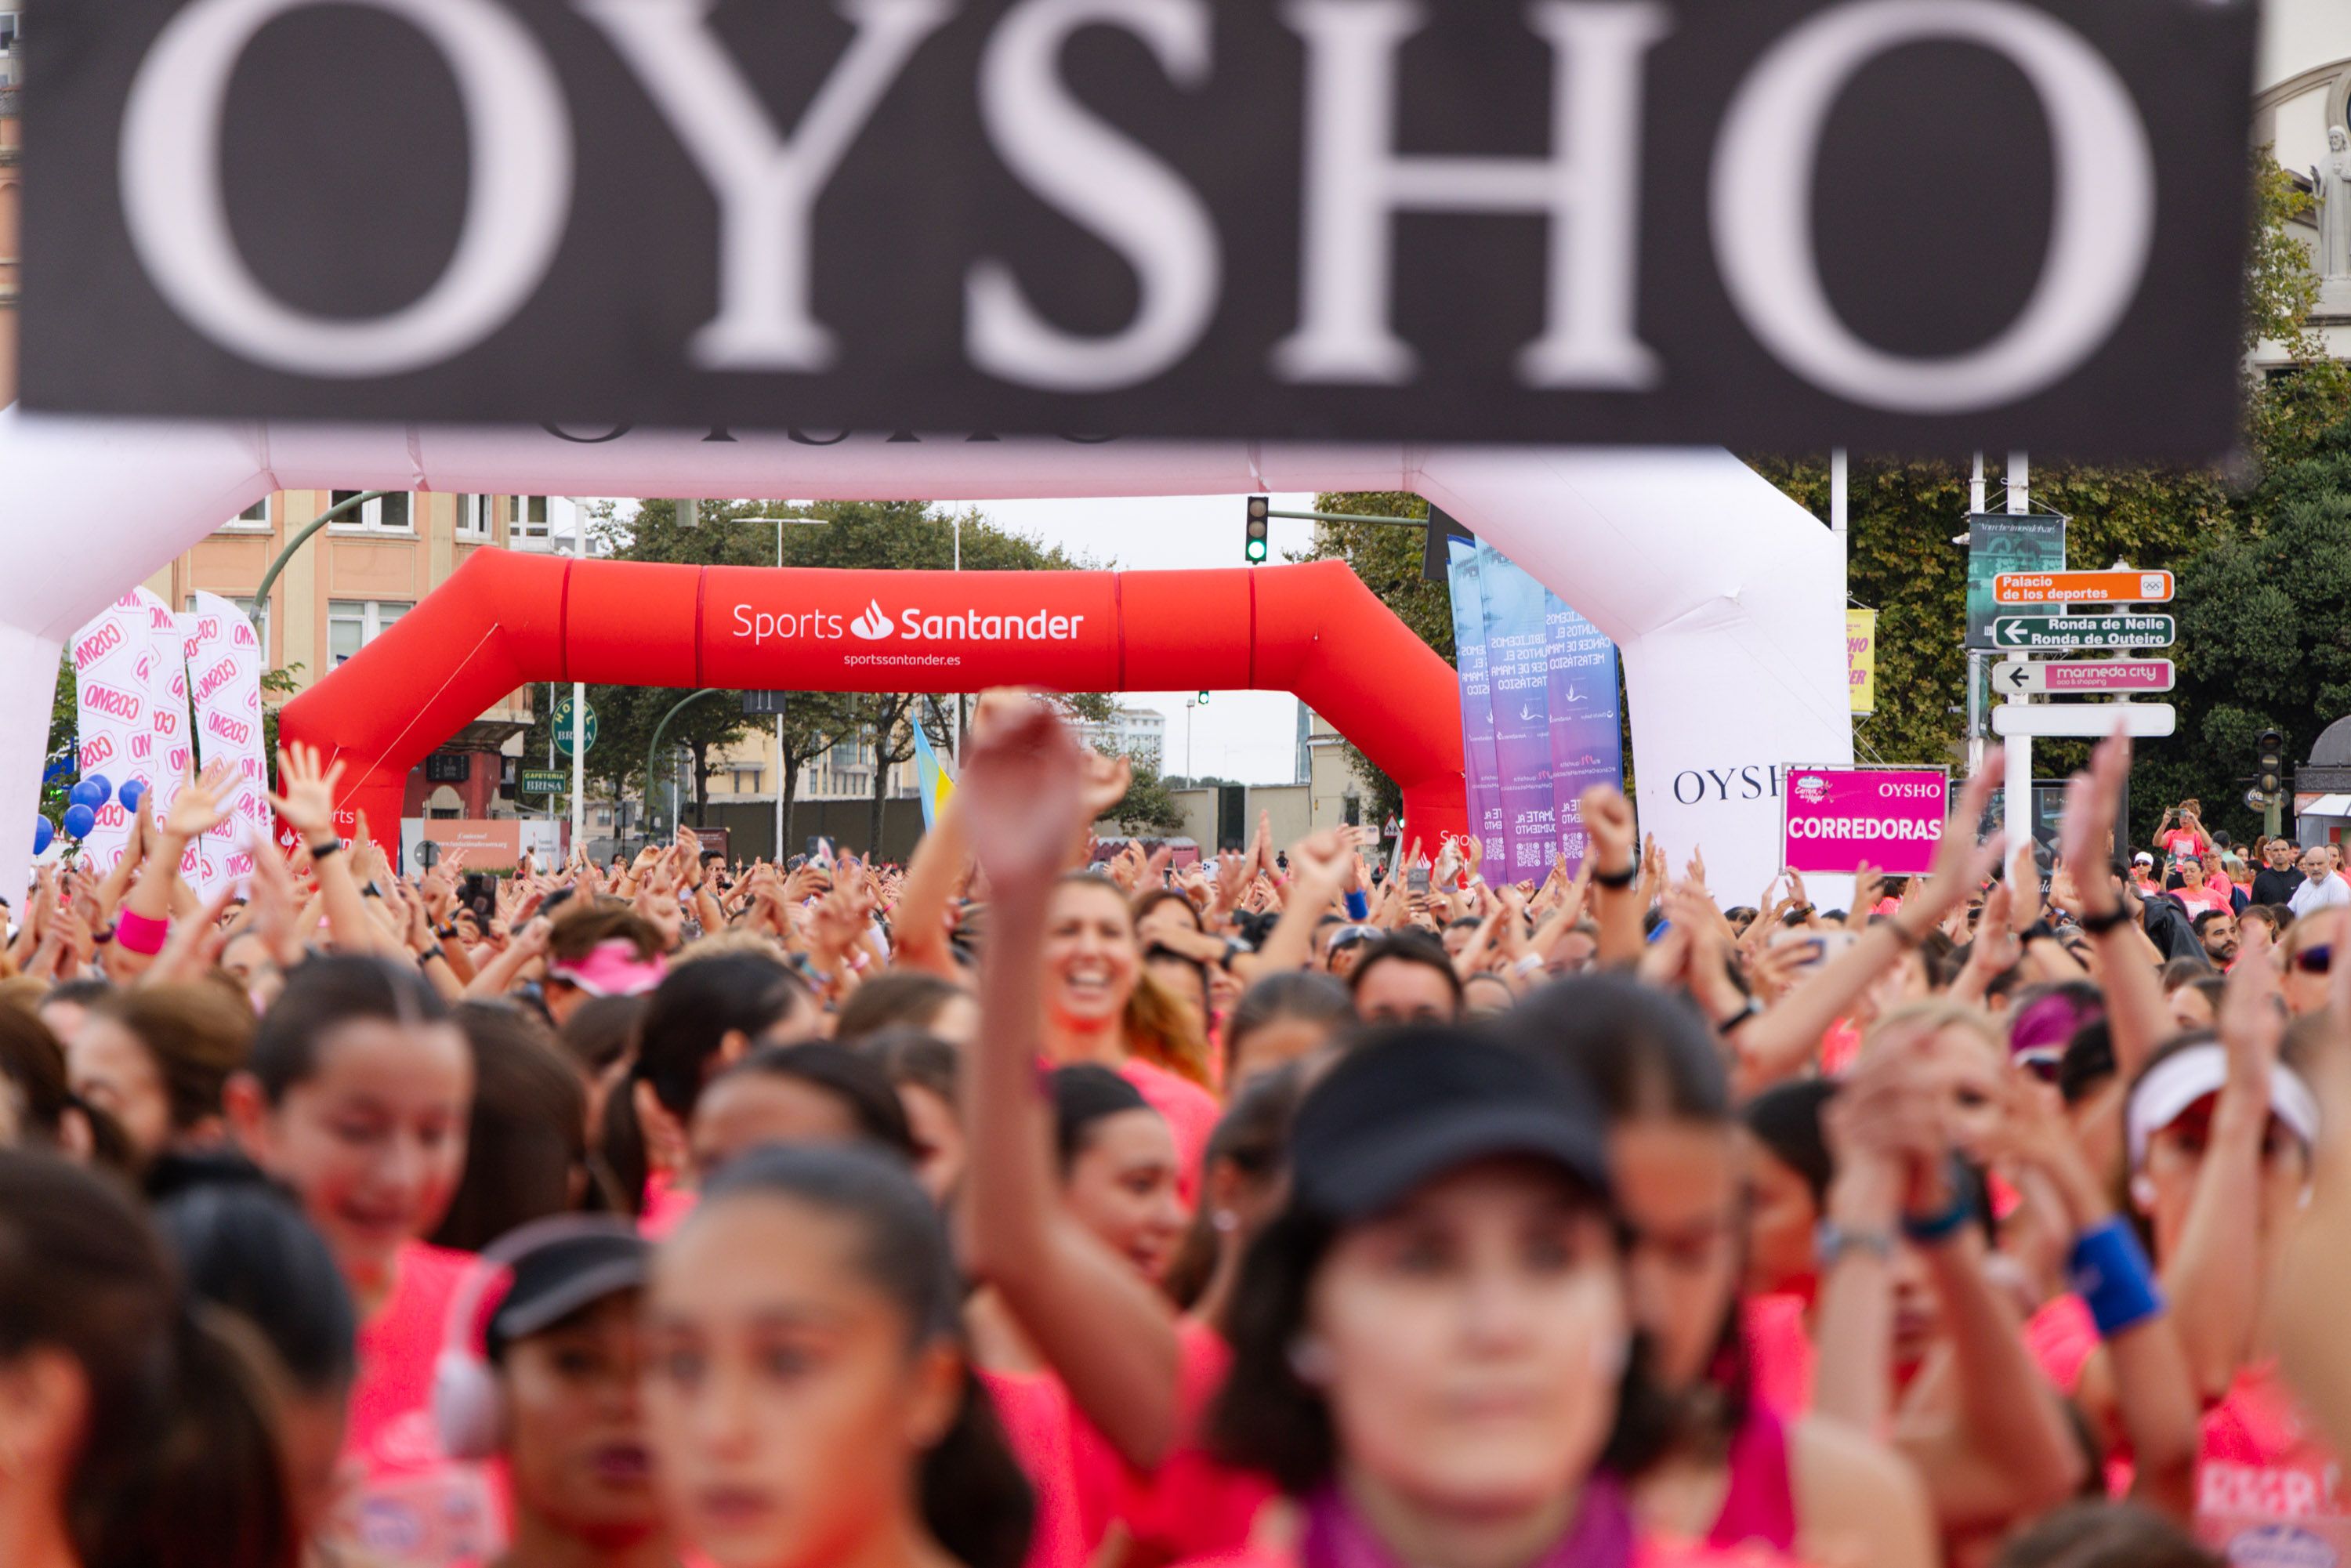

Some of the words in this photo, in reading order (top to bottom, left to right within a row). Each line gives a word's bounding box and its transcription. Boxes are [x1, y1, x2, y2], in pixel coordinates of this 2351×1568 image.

[118, 0, 2155, 415] OYSHO
[2003, 576, 2052, 587] Palacio
[2003, 589, 2020, 599] de
[2024, 588, 2043, 599] los
[2048, 588, 2108, 601] deportes
[733, 603, 842, 646] Sports
[901, 608, 1084, 639] Santander
[2049, 618, 2097, 630] Ronda
[2102, 618, 2121, 630] de
[2126, 618, 2164, 630] Nelle
[2032, 633, 2080, 645] Ronda
[2085, 633, 2103, 645] de
[2108, 633, 2165, 645] Outeiro
[844, 654, 961, 667] sportssantander.es
[2057, 666, 2127, 678] marineda
[2129, 666, 2156, 682] city
[555, 703, 594, 725] HOEL
[557, 730, 592, 741] BRA
[527, 780, 563, 791] BRISA
[1674, 765, 1791, 804] OYSH
[1878, 784, 1941, 798] OYSHO
[1788, 817, 1942, 840] CORREDORAS
